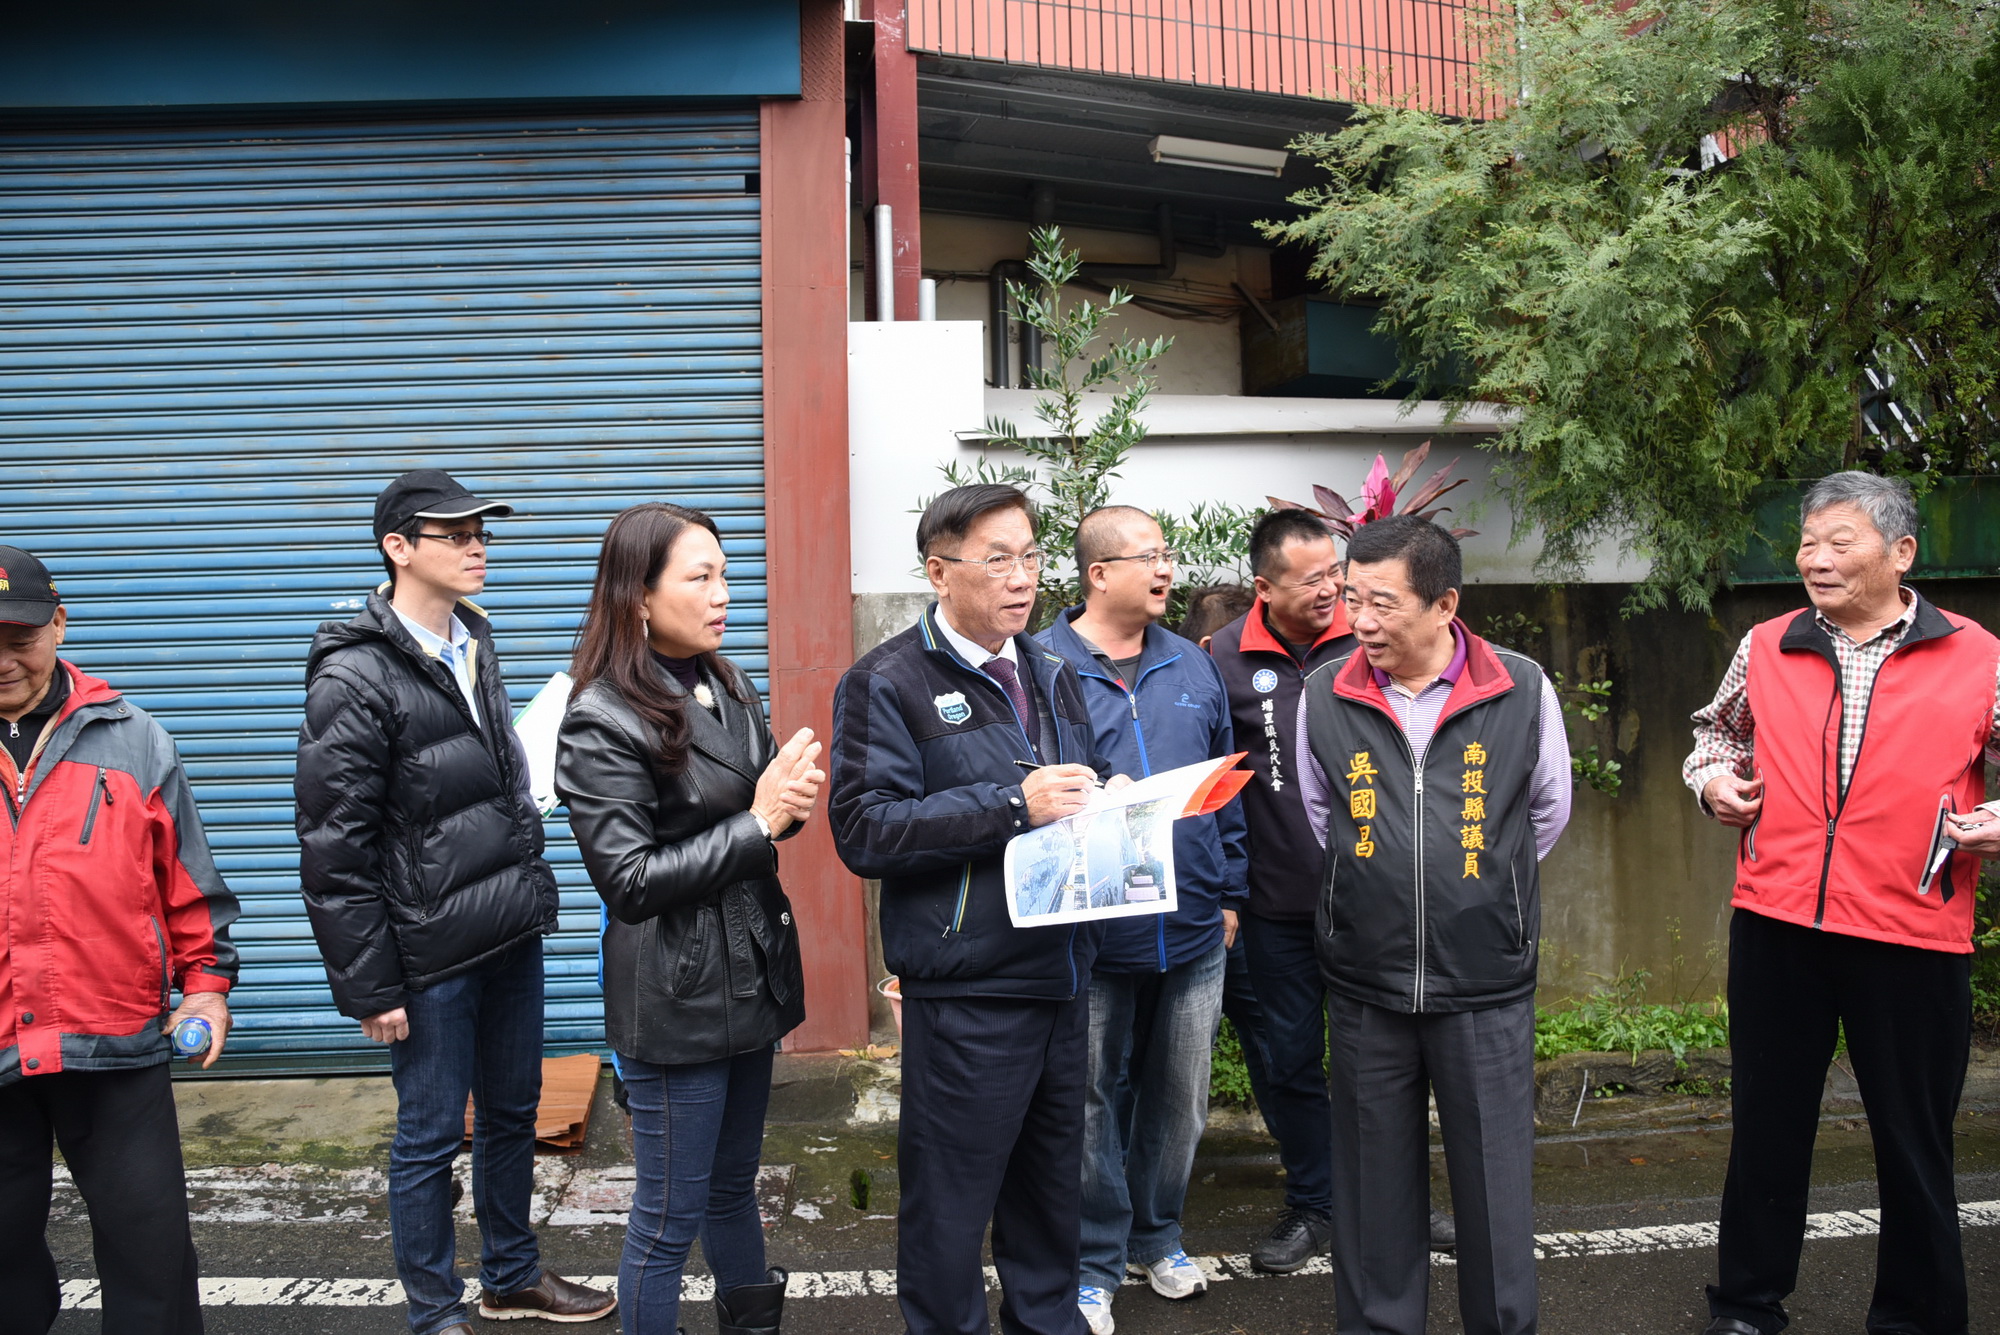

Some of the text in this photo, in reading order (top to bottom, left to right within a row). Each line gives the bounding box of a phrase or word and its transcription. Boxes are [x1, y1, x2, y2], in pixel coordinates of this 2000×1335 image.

[1261, 698, 1285, 792] 埔里鎮民代表會
[1346, 751, 1379, 859] 吳國昌
[1460, 741, 1488, 879] 南投縣議員
